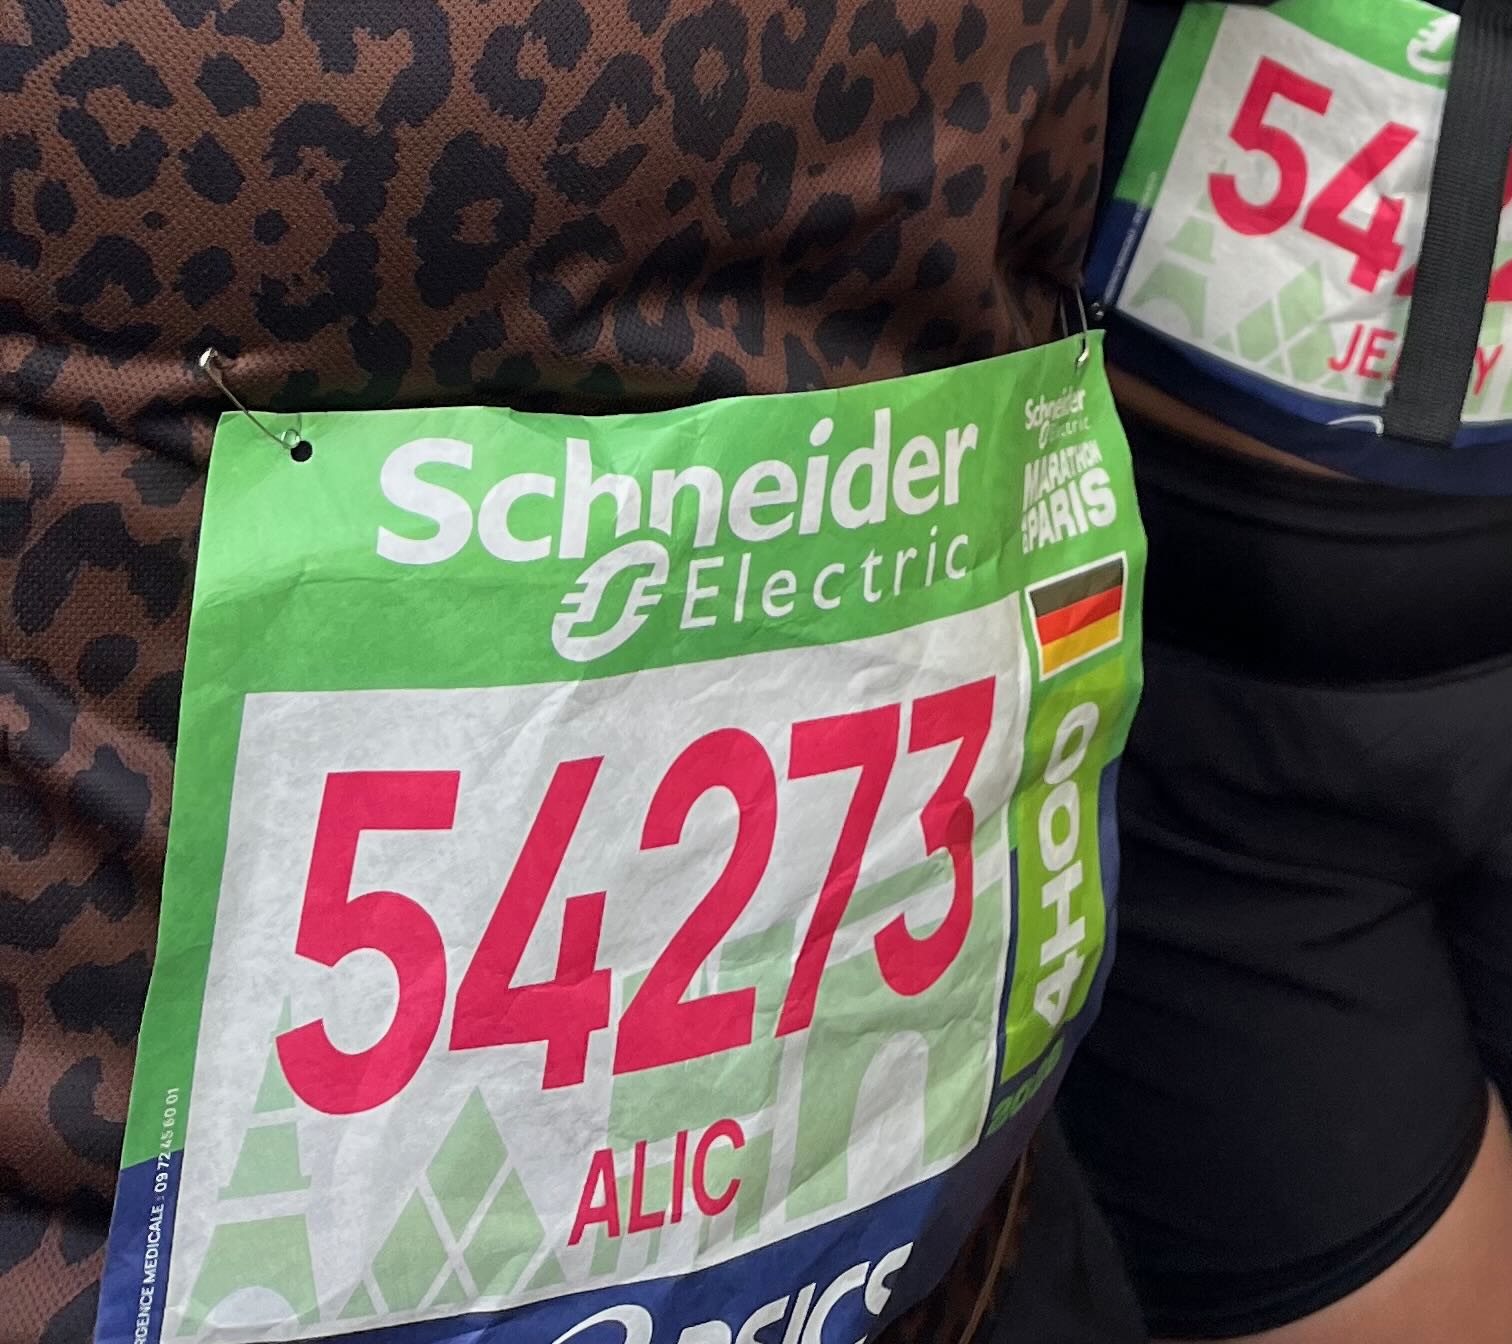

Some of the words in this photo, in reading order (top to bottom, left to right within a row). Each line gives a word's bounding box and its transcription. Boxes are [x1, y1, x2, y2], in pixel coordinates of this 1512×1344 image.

[375, 409, 979, 566] Schneider
[1023, 439, 1104, 513] MARATHON
[1027, 466, 1118, 551] PARIS
[678, 527, 970, 631] Electric
[274, 675, 996, 1115] 54273
[1033, 701, 1100, 1027] 4H00
[156, 1151, 172, 1170] 72
[567, 1118, 746, 1246] ALIC
[143, 1203, 165, 1284] MEDICALE
[133, 1286, 155, 1344] RGENCE
